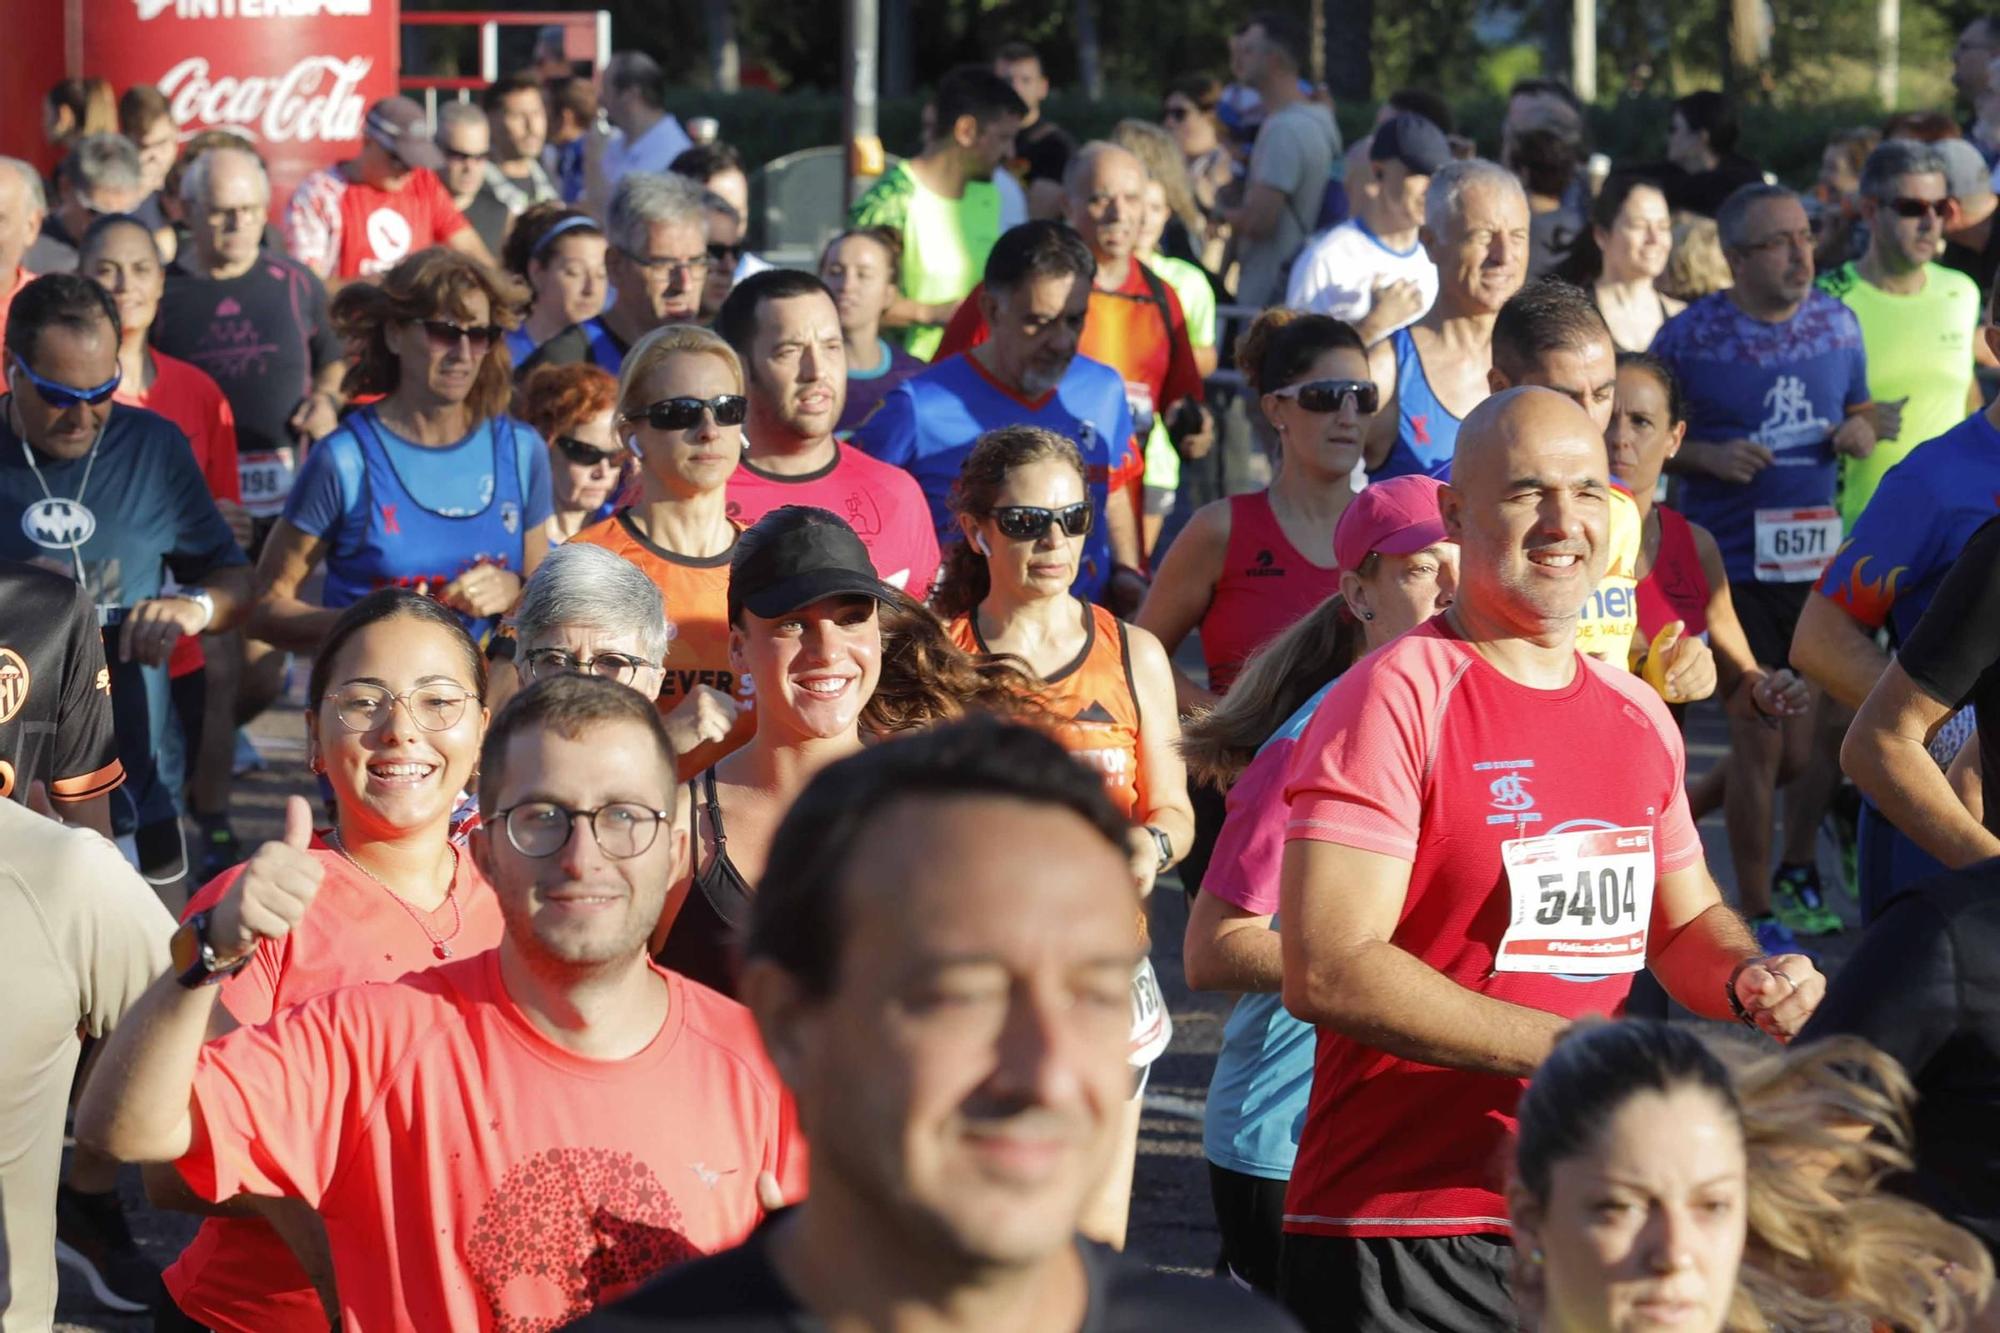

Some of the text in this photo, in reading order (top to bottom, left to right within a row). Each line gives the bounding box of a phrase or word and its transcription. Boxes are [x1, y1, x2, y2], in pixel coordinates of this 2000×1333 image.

[157, 55, 373, 142] Coca-Cola
[1775, 527, 1826, 556] 6571
[1535, 865, 1636, 927] 5404
